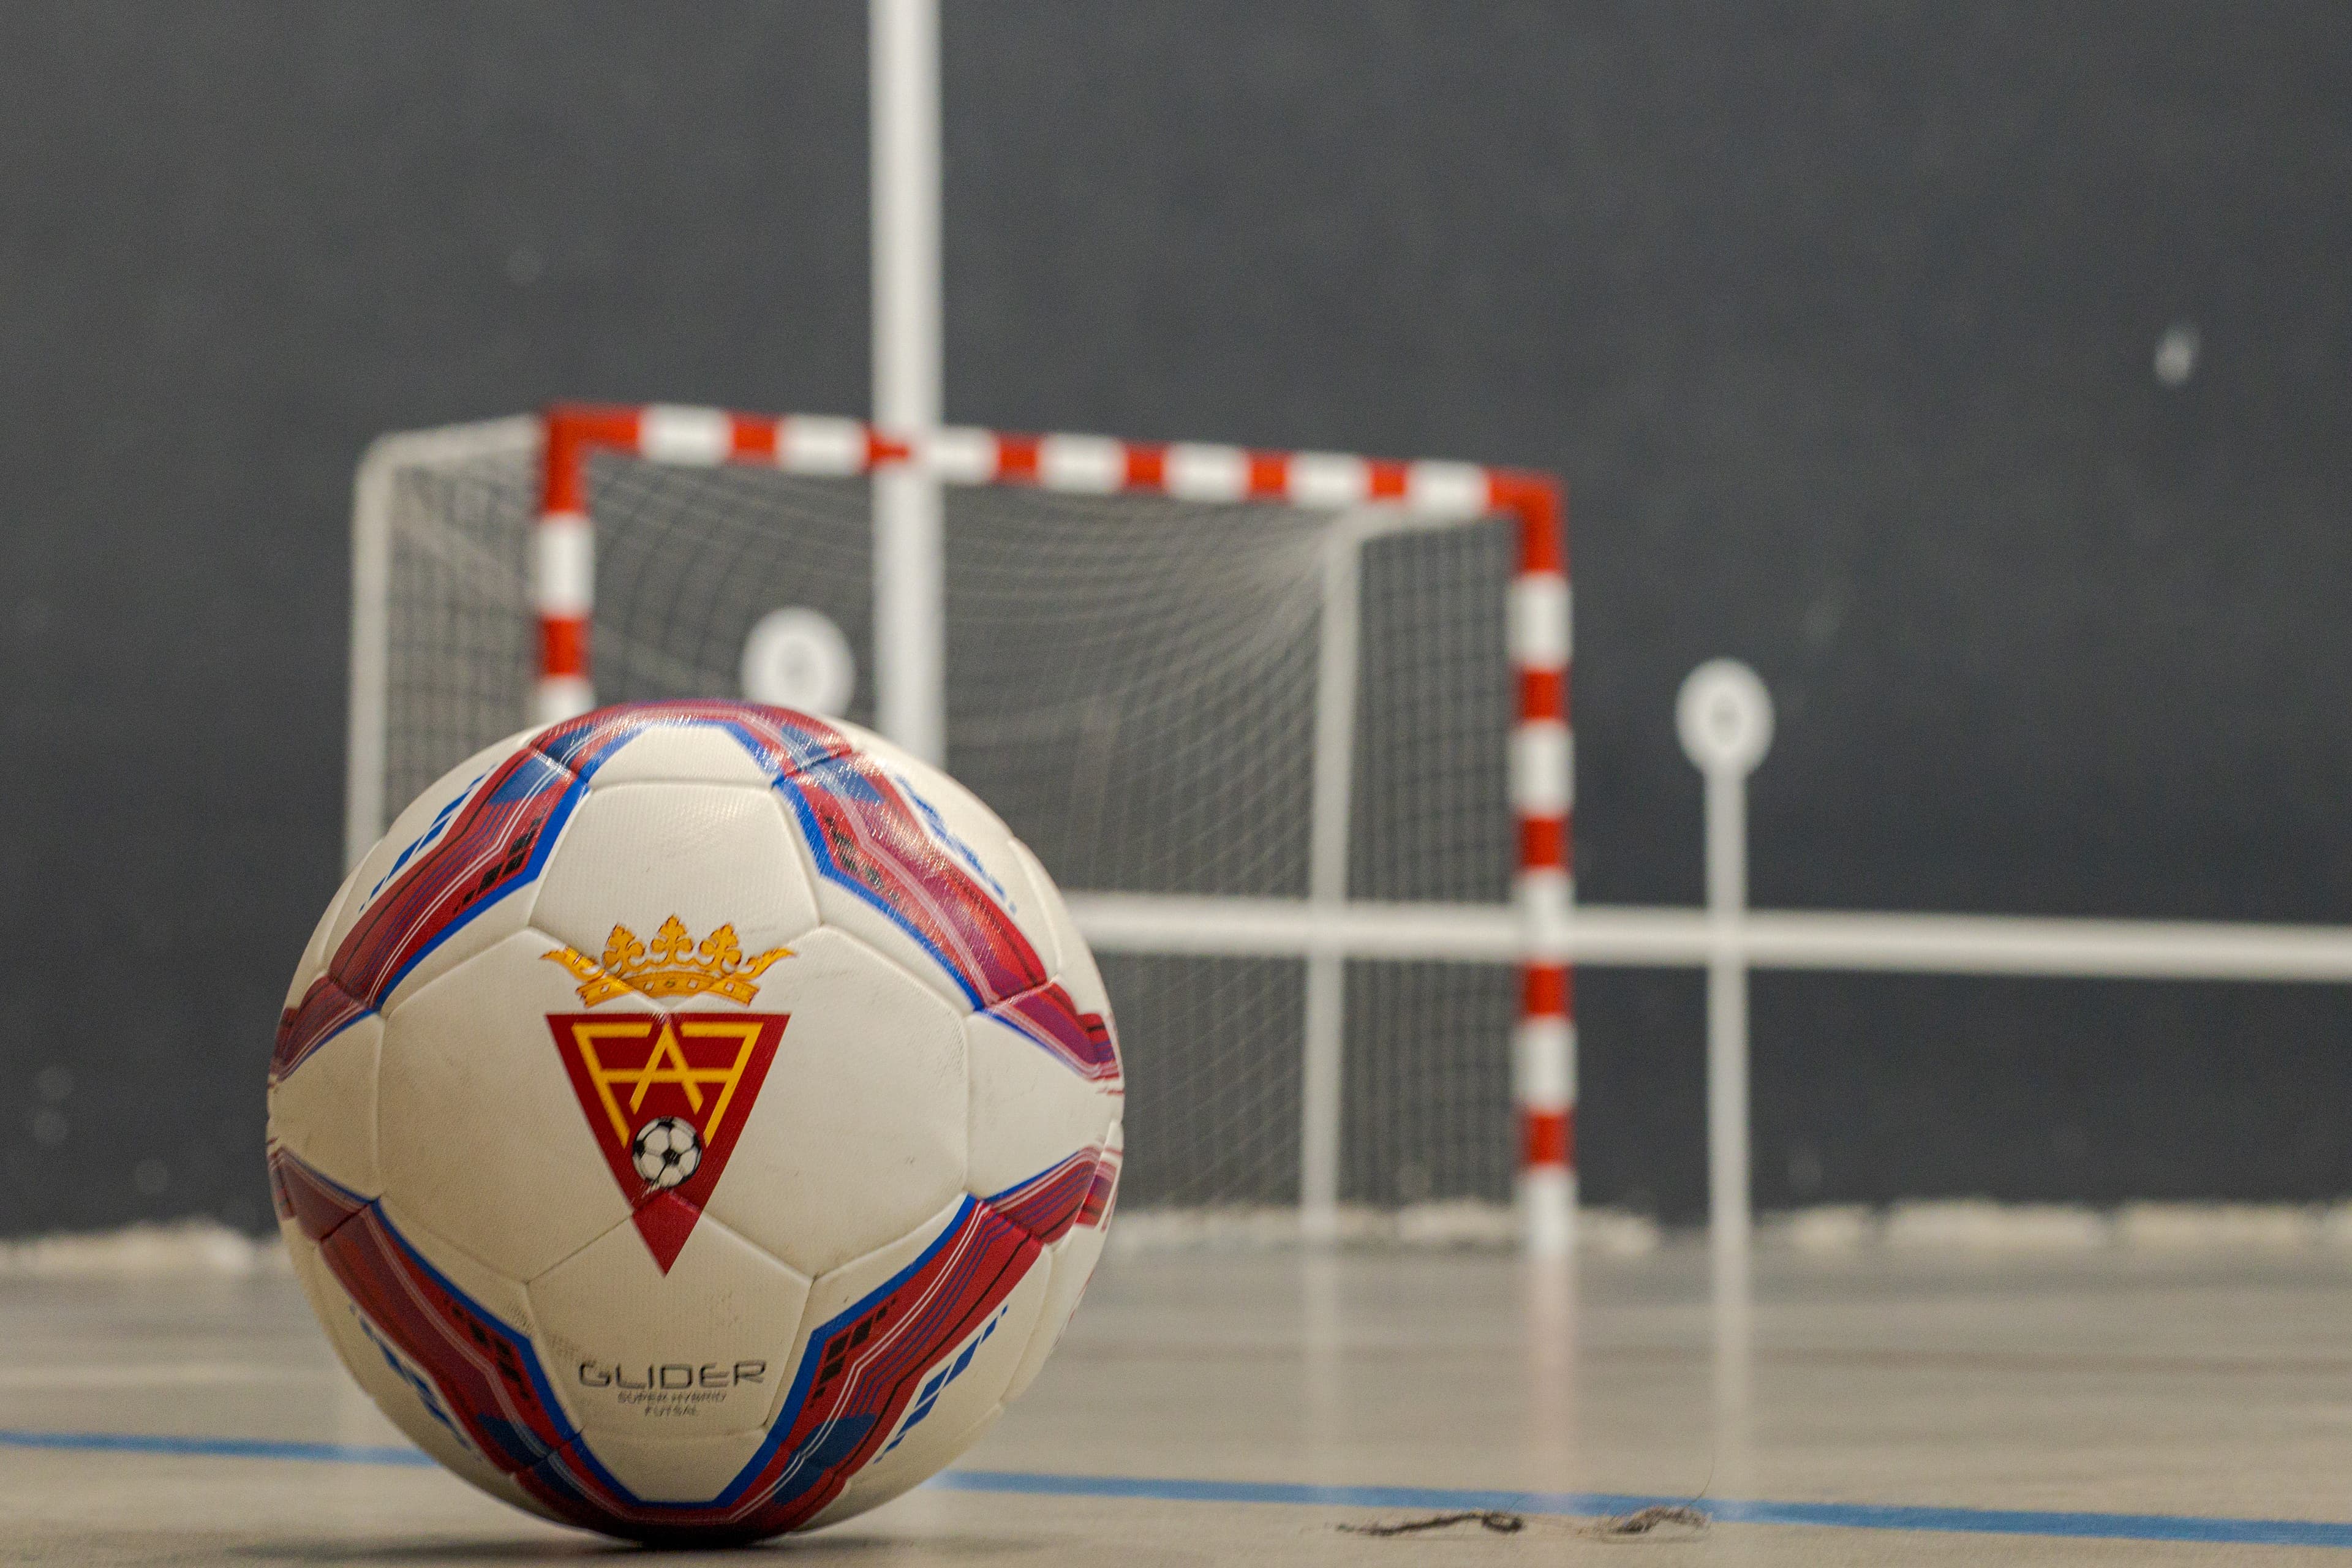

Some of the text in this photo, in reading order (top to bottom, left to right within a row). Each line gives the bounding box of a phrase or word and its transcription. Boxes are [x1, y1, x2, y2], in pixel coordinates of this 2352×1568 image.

[579, 1359, 766, 1389] GLIDER
[617, 1390, 668, 1403] SUPER
[644, 1404, 697, 1417] FUTSAL
